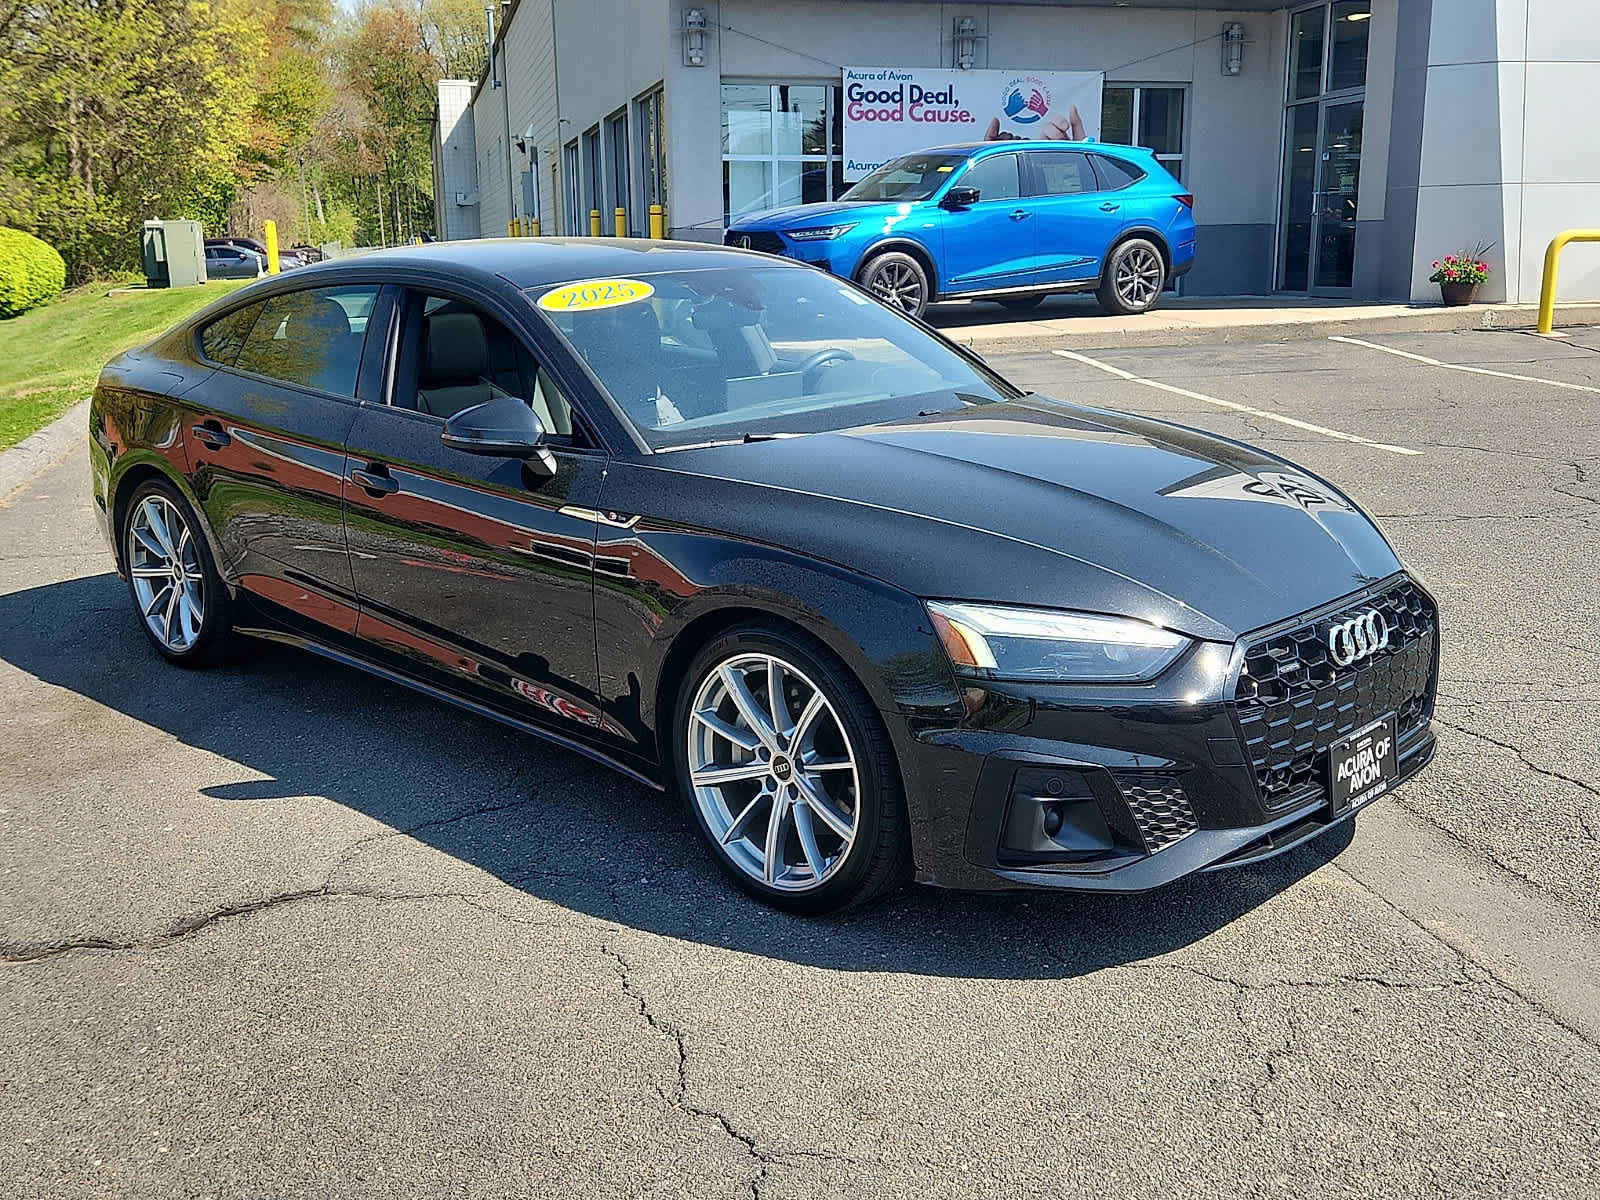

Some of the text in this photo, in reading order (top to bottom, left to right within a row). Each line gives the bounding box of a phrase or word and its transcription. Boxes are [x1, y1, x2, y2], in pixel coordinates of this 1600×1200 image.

[846, 70, 913, 81] Acura of Avon
[847, 83, 959, 108] Good Deal,
[847, 101, 976, 123] Good Cause.
[562, 283, 635, 307] 2025
[1337, 736, 1391, 782] ACURA OF
[1349, 760, 1381, 793] AVON
